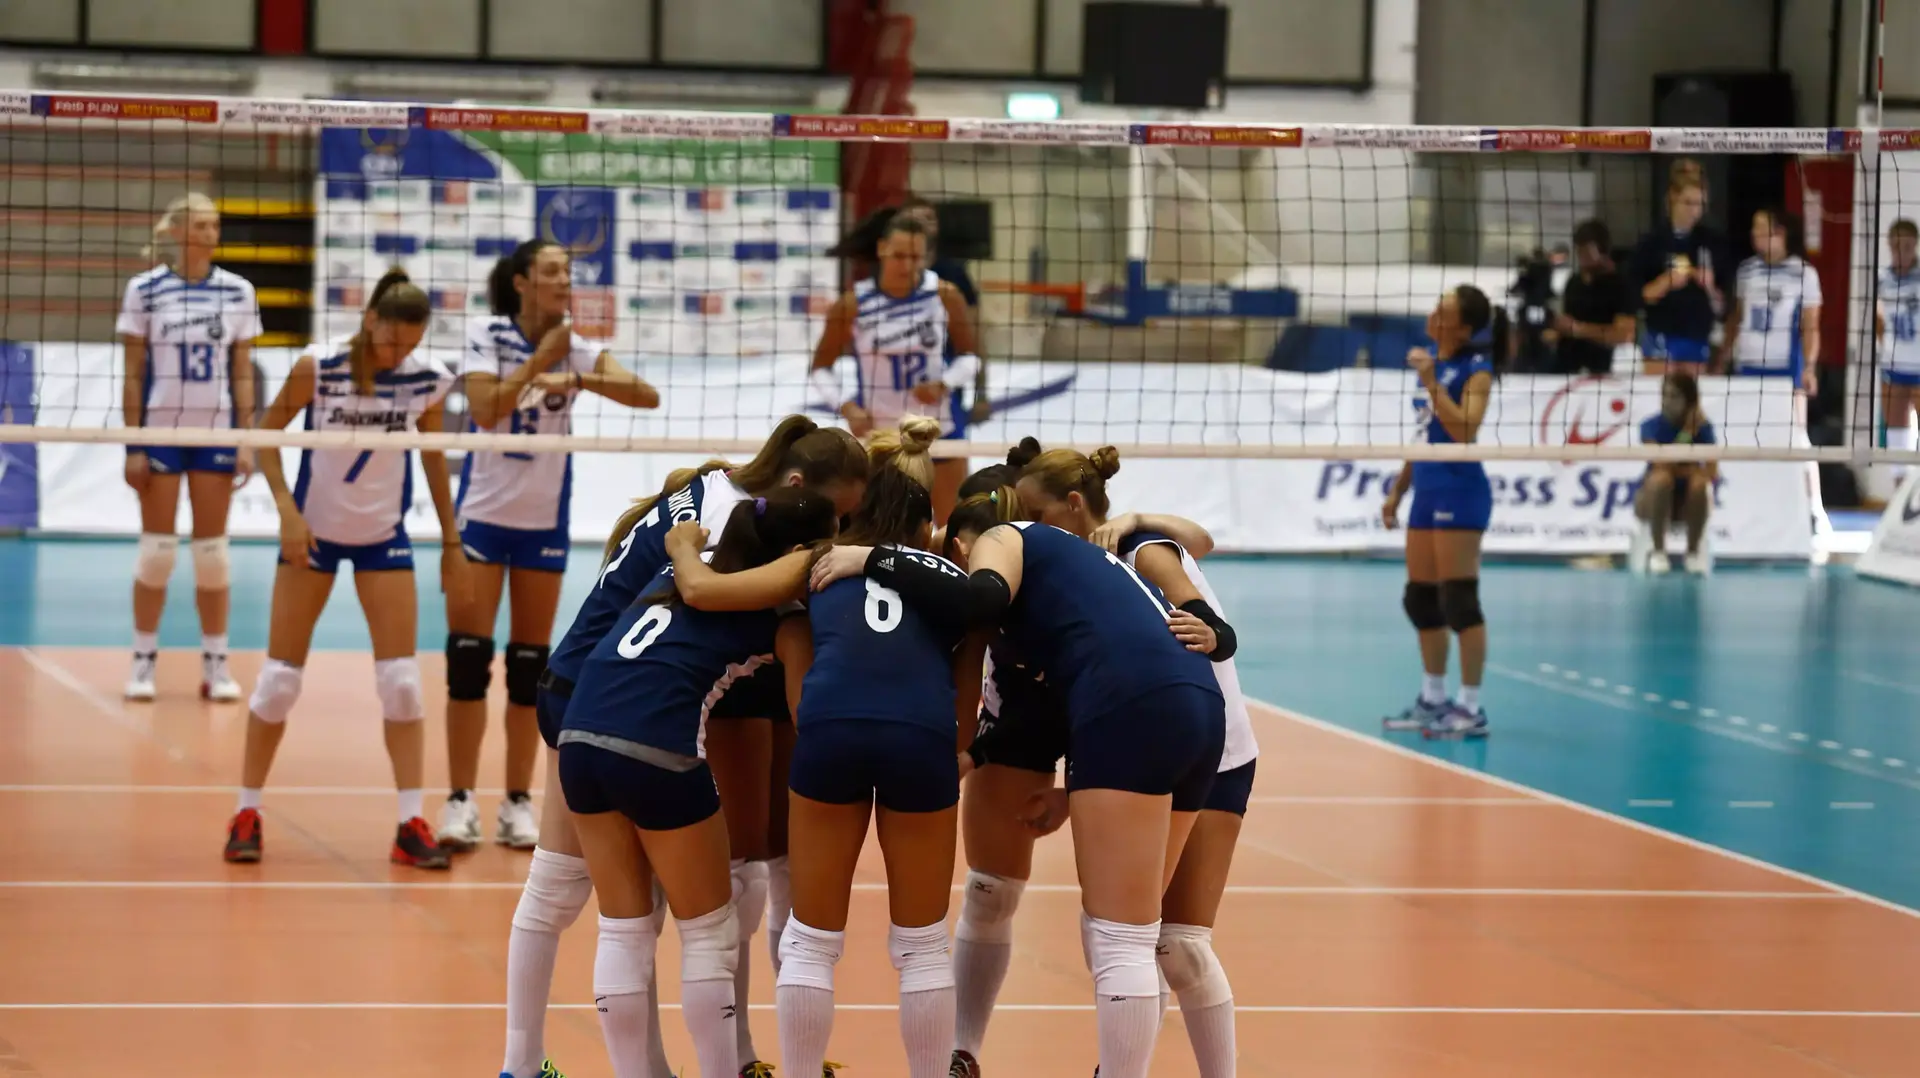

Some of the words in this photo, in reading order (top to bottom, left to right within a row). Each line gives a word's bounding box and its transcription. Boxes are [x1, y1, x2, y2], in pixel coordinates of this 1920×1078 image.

[55, 101, 84, 112] FAIR
[87, 102, 119, 113] PLAY
[175, 342, 214, 382] 13
[888, 351, 928, 392] 12
[877, 561, 895, 572] adidas
[617, 604, 672, 659] 0
